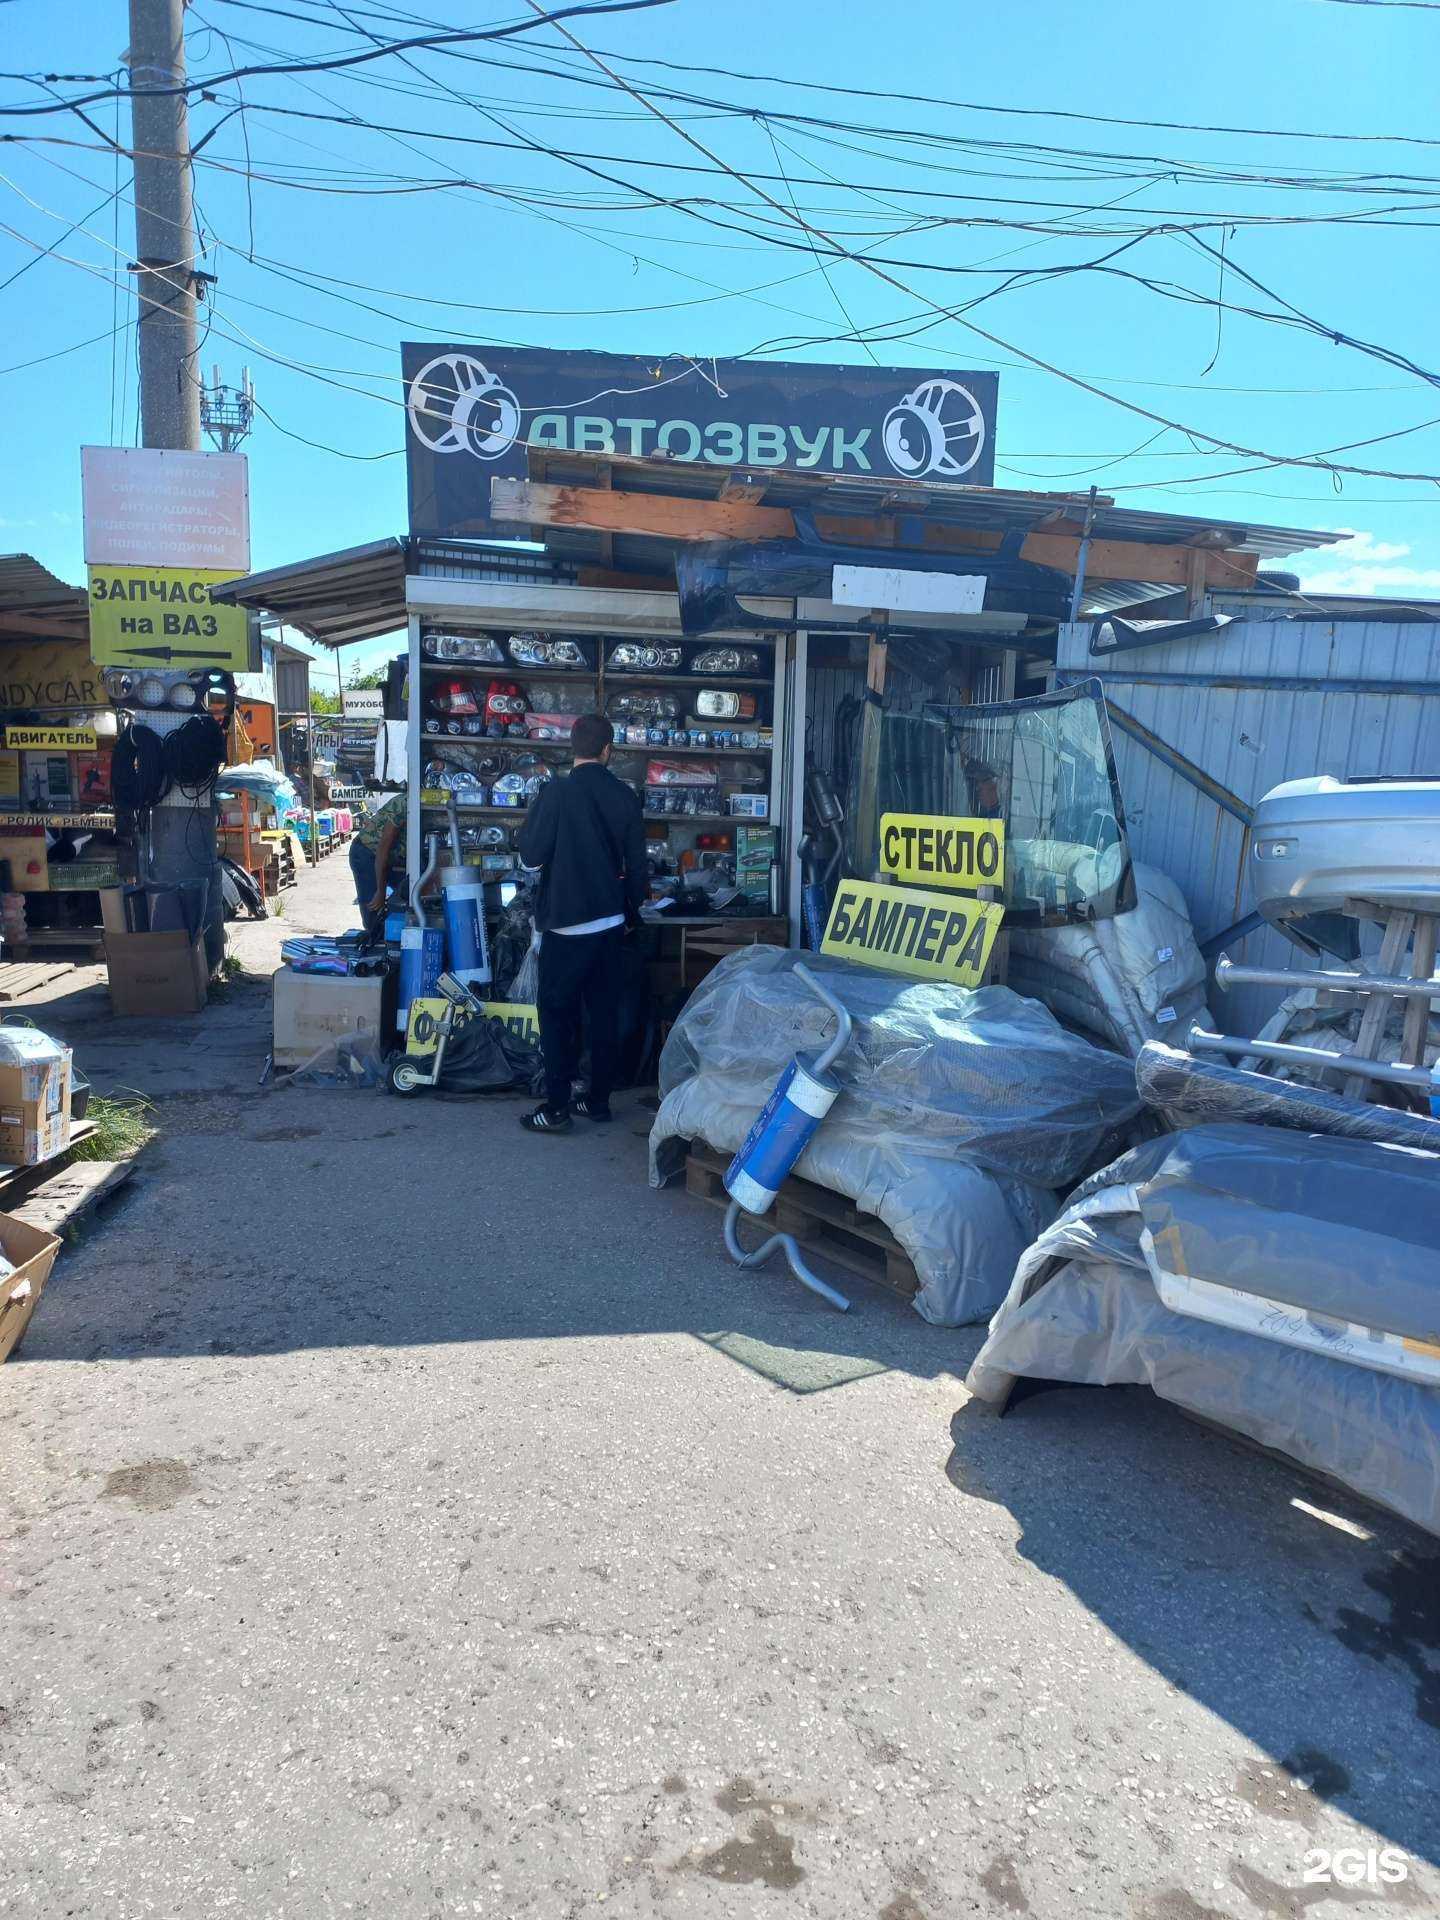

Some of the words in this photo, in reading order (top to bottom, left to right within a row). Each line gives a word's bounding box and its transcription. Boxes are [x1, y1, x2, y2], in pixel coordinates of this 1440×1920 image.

[527, 414, 872, 470] АВТОЗВУК
[92, 577, 236, 606] ЗАПЧАС
[120, 617, 154, 634] на
[163, 613, 218, 637] ВАЗ
[9, 731, 95, 746] ДВИГАТЕЛЬ
[331, 788, 375, 799] БАМПЕРА
[7, 815, 53, 827] РОЛИК
[884, 825, 999, 878] СТЕКЛО
[828, 893, 987, 971] БАМПЕРА
